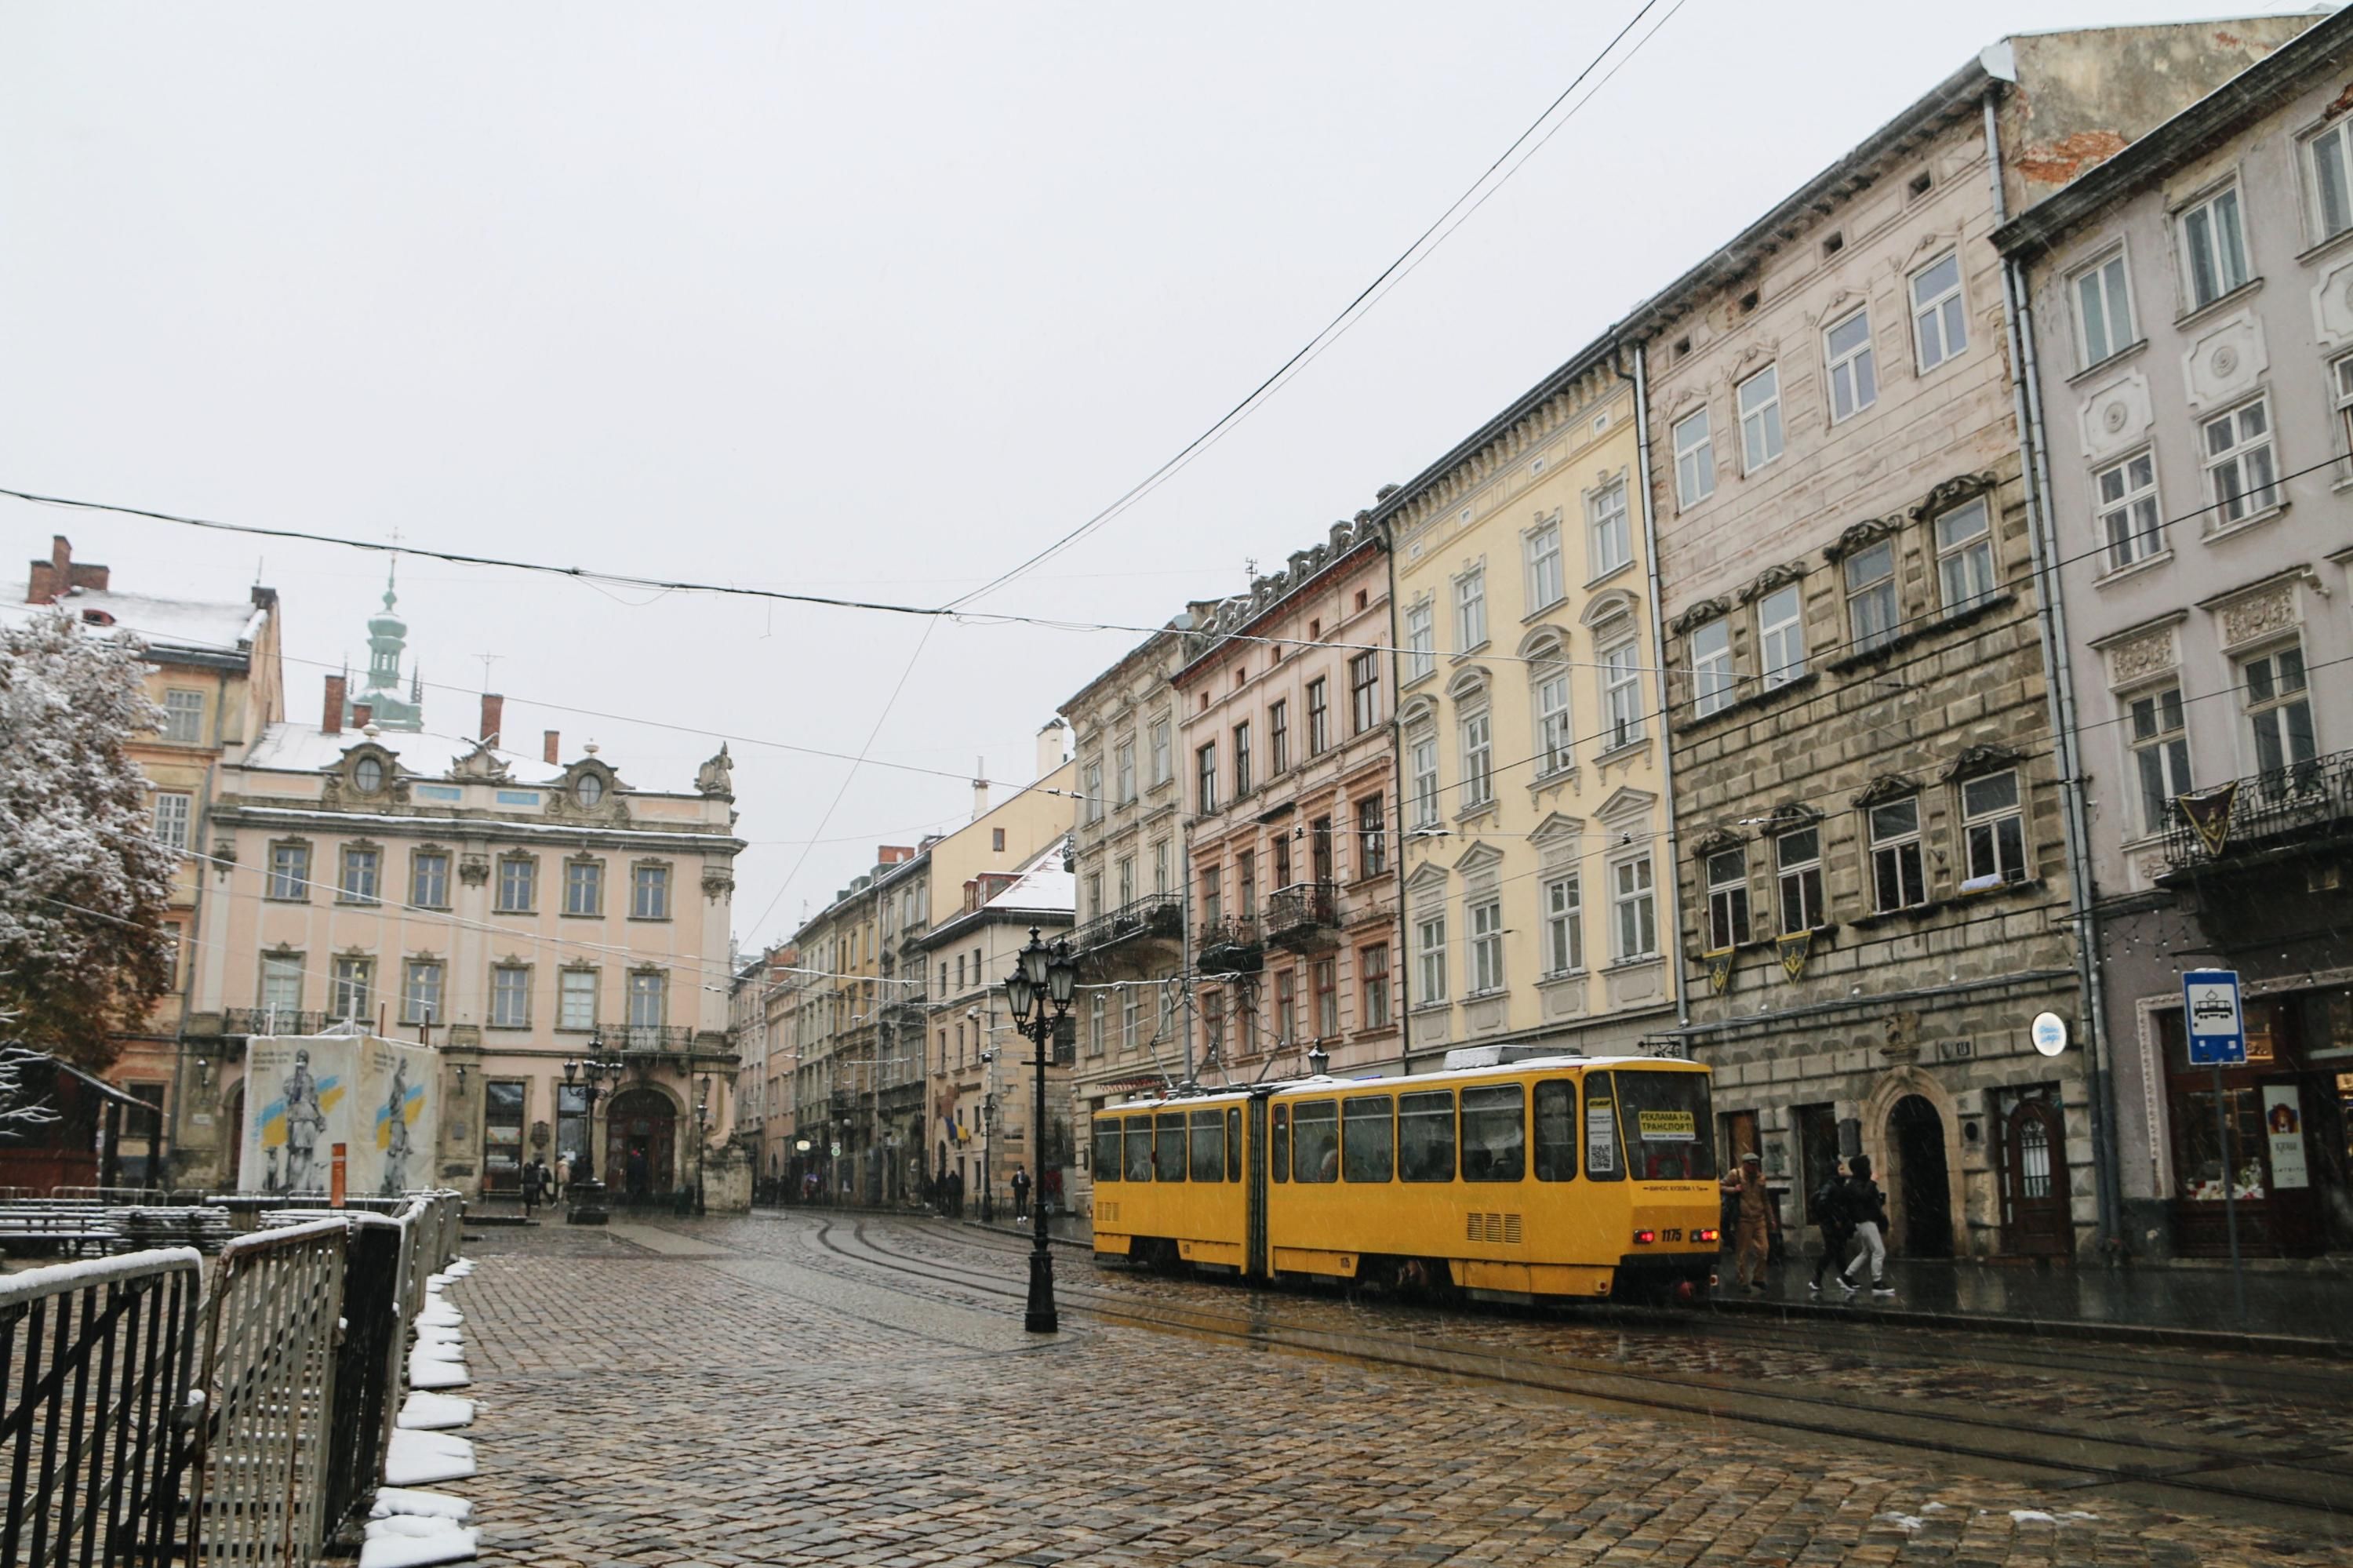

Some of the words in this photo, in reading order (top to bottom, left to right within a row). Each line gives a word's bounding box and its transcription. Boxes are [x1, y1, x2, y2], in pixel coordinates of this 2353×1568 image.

[1640, 1112, 1678, 1121] РЕКЛАМА
[1679, 1112, 1691, 1121] НА
[1661, 1228, 1682, 1242] 1175
